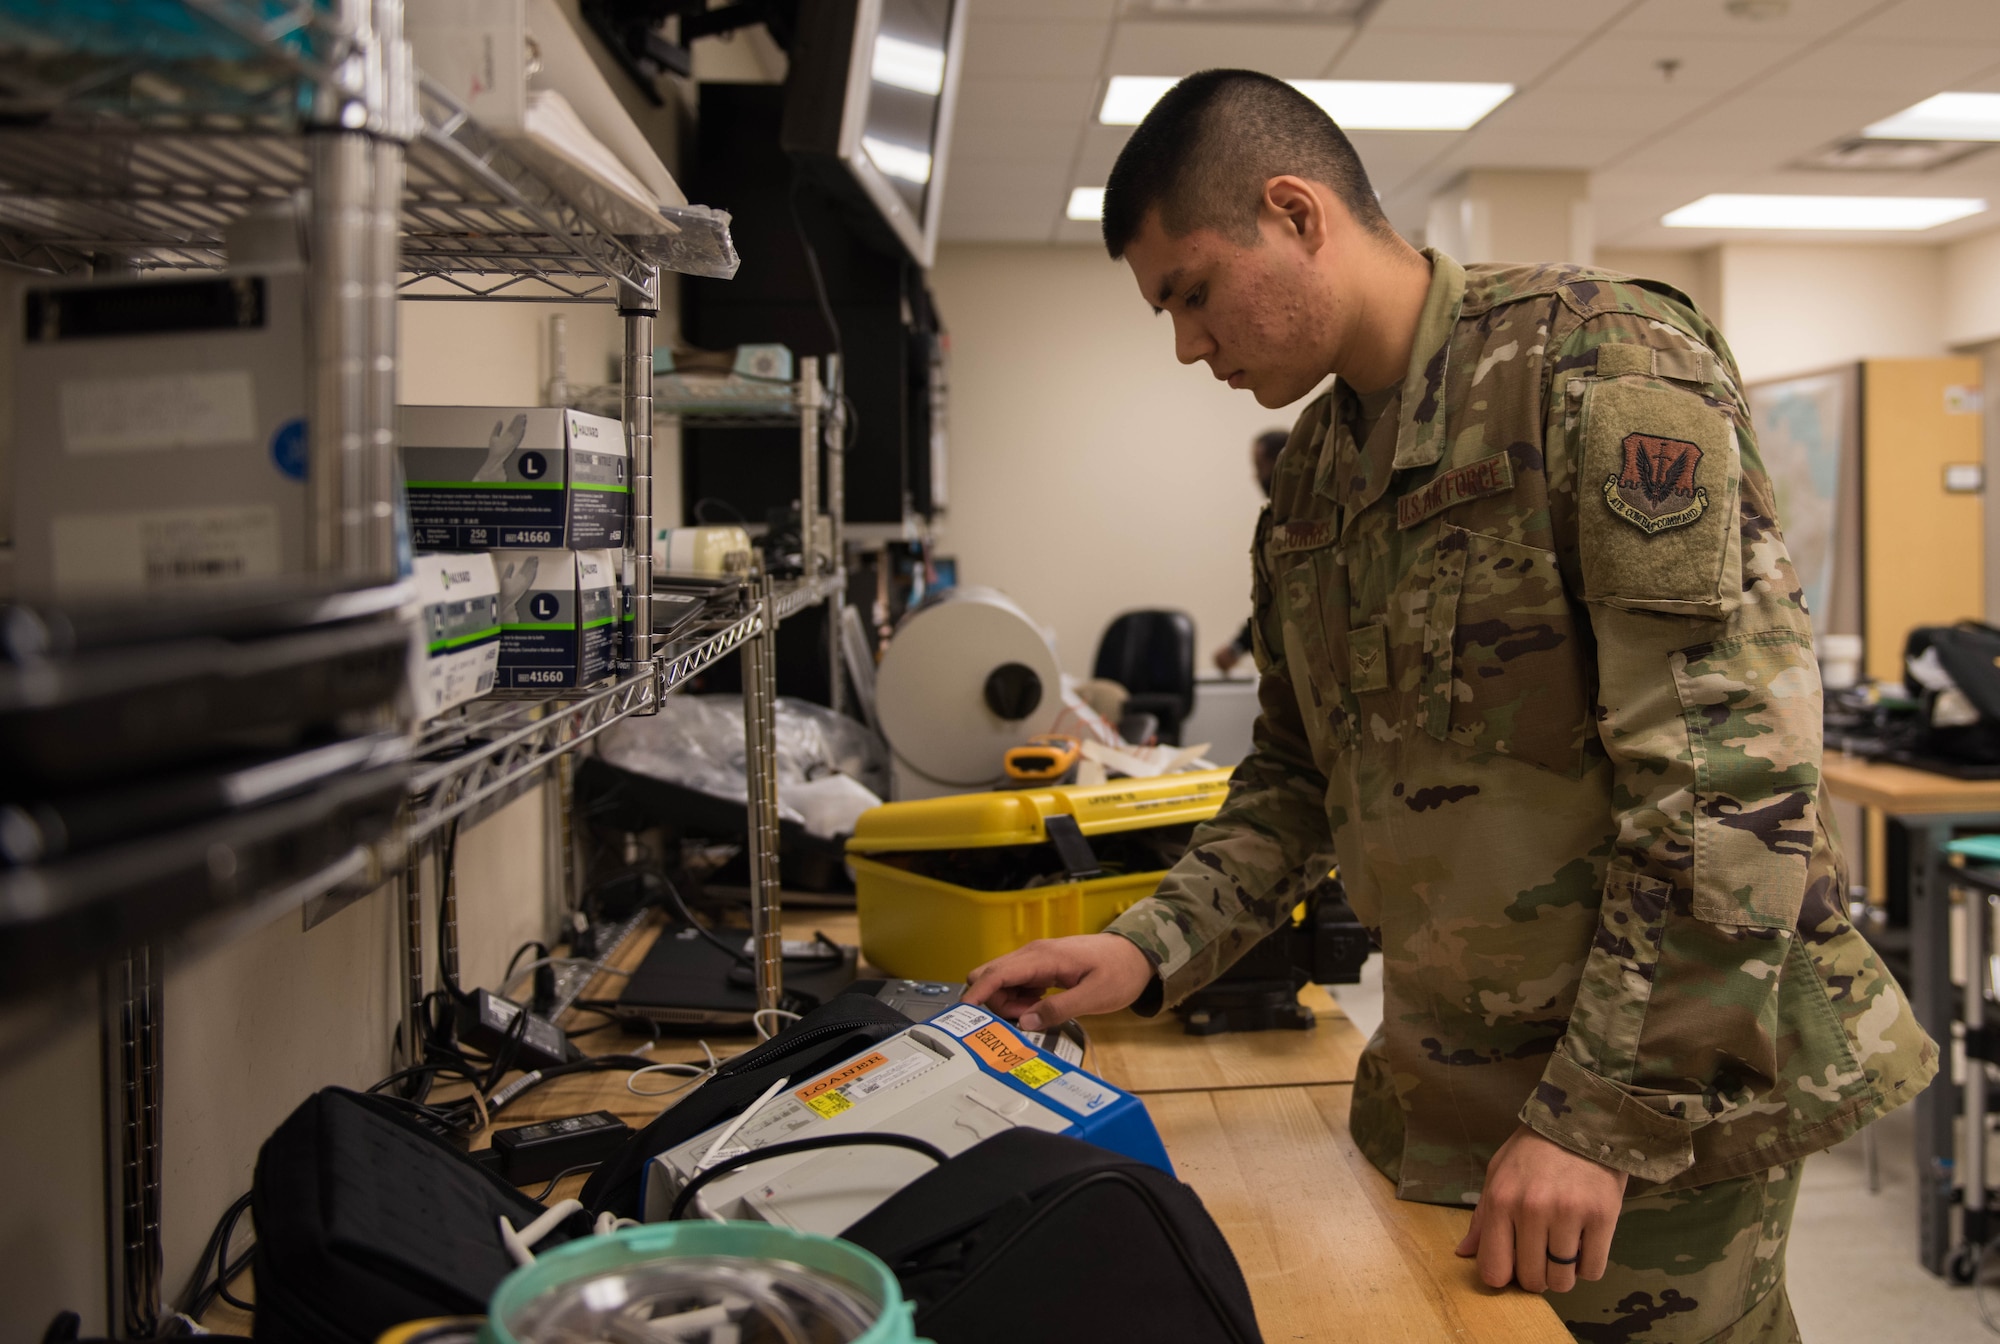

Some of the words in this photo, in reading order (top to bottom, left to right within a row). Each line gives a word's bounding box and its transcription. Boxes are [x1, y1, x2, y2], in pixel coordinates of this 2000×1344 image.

[527, 458, 538, 474] L
[1423, 482, 1442, 513] AIR
[1445, 459, 1503, 500] FORCE
[1610, 497, 1624, 511] AIR
[1657, 508, 1698, 528] COMMAND
[470, 529, 487, 538] 250
[517, 531, 551, 543] 41660
[539, 599, 550, 615] L
[530, 671, 564, 682] 41660
[974, 1027, 1026, 1067] LOANER
[802, 1055, 884, 1098] LOANER
